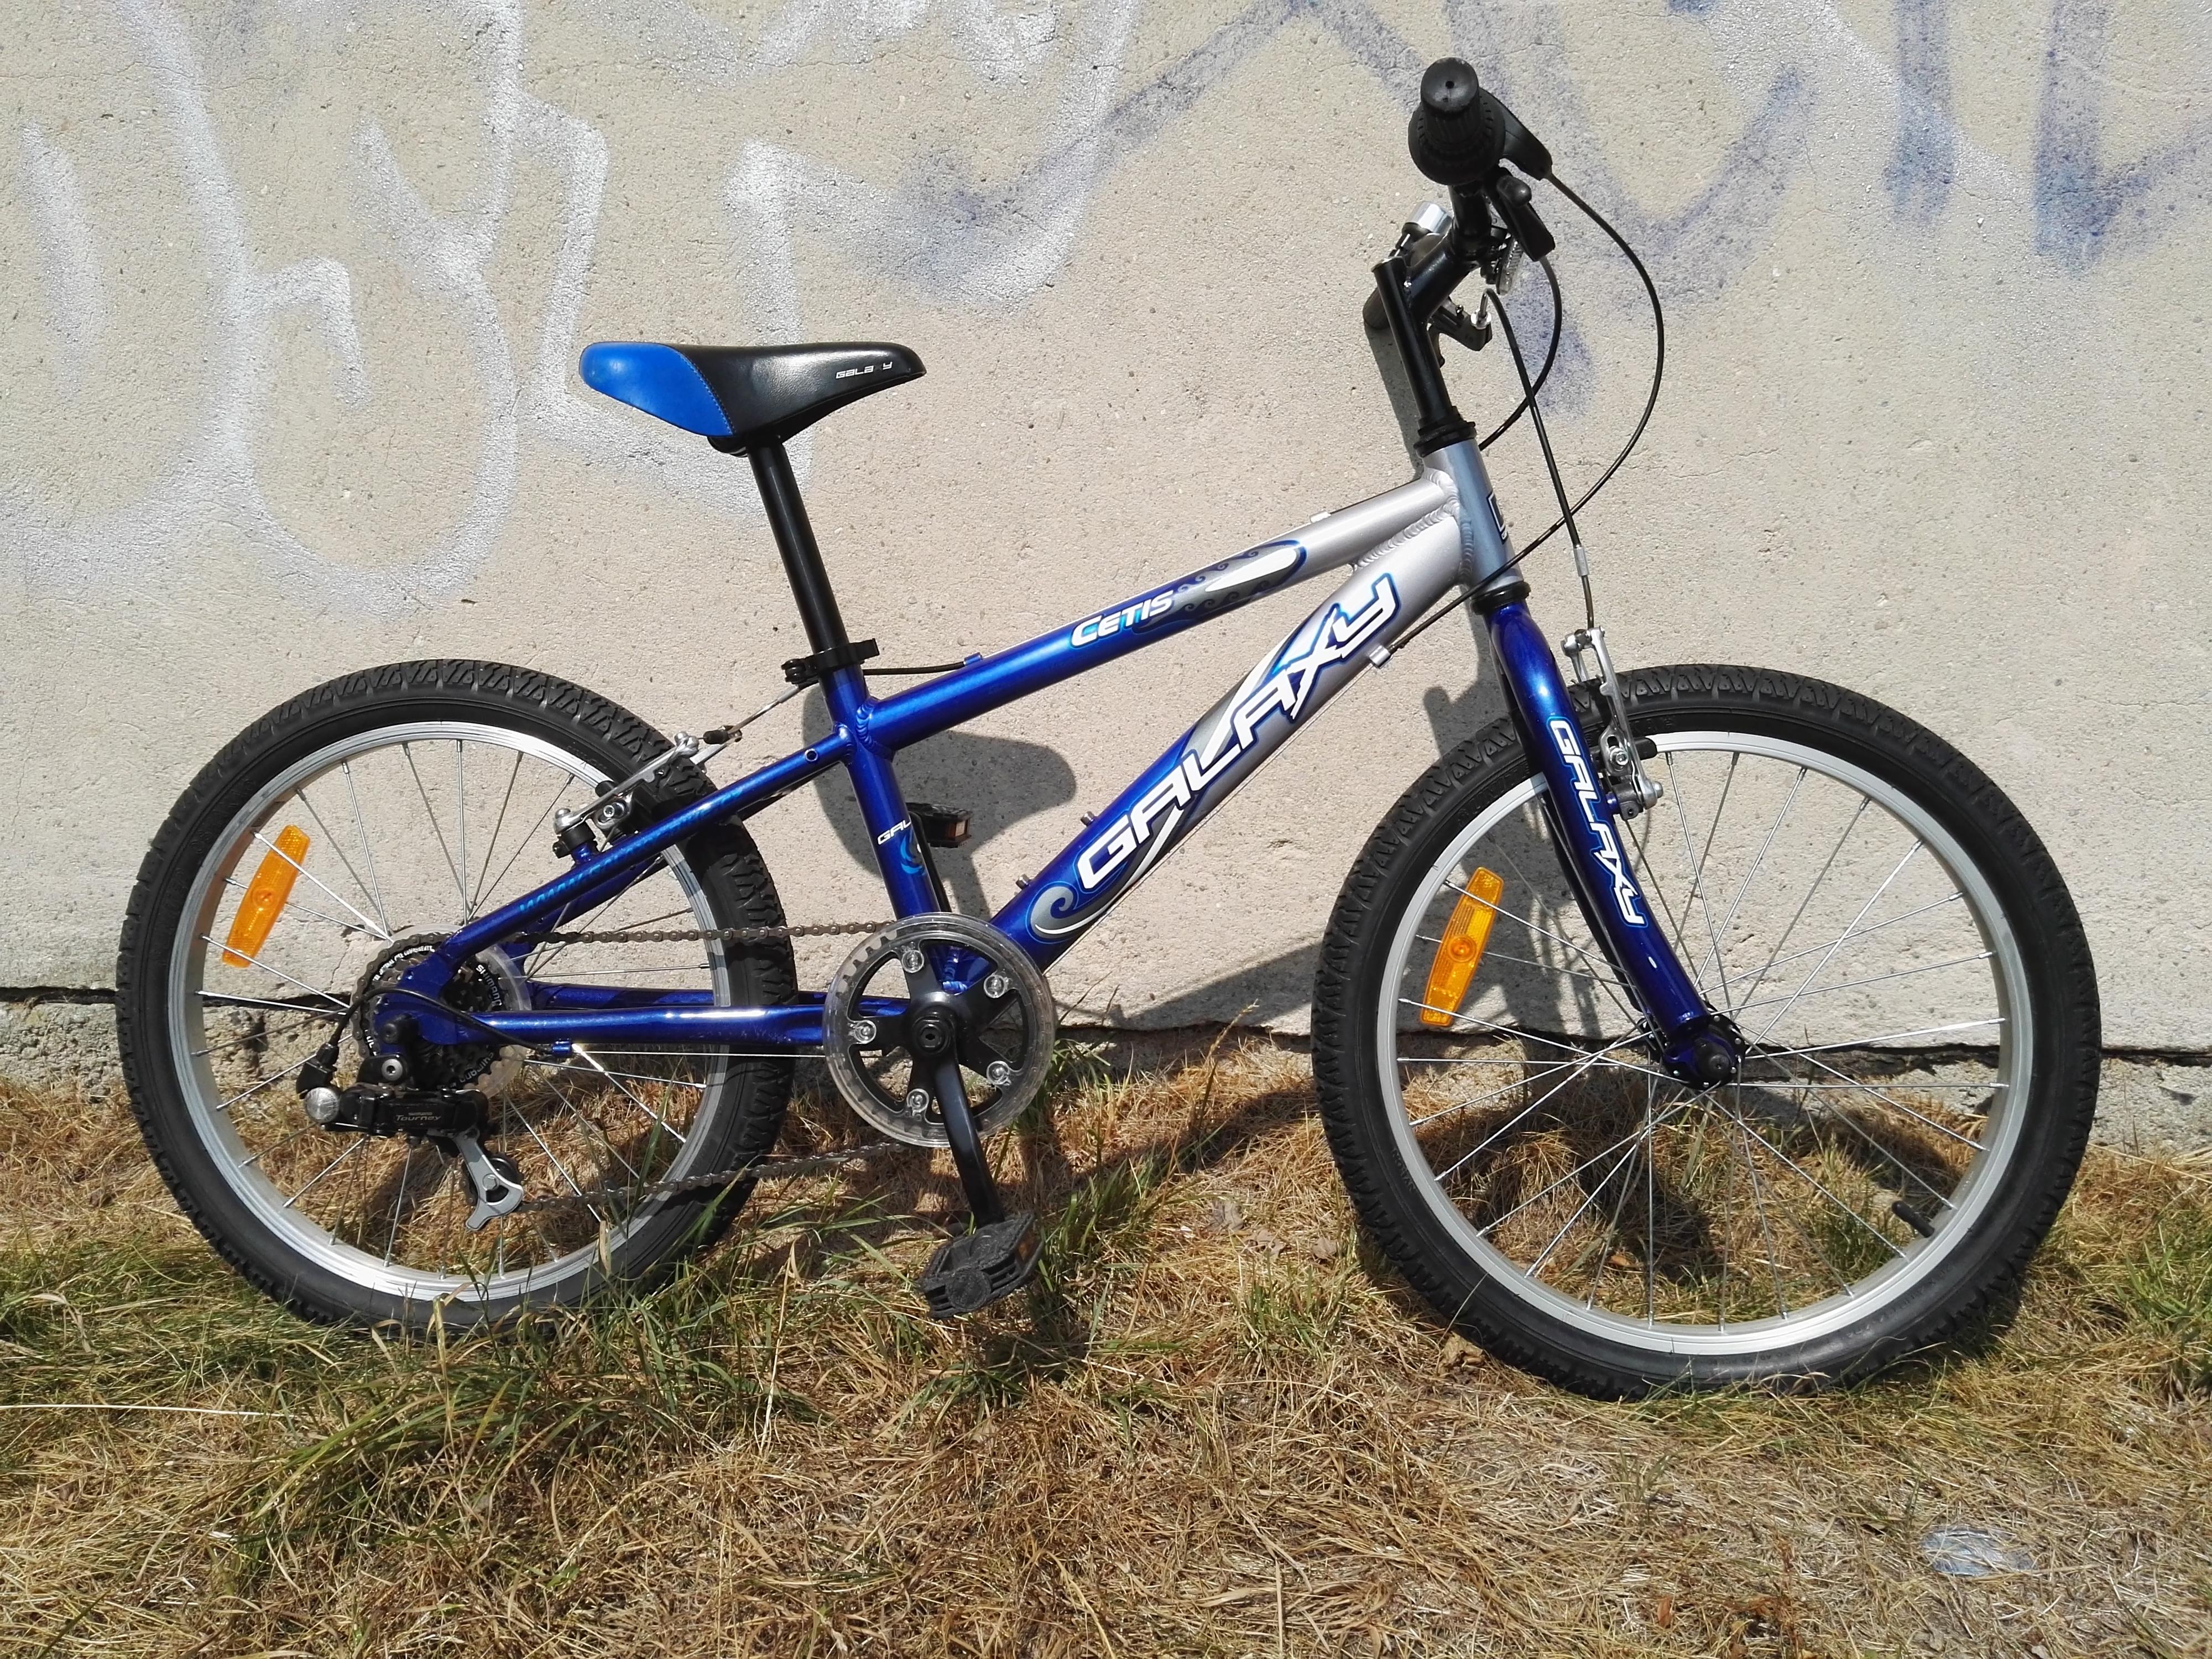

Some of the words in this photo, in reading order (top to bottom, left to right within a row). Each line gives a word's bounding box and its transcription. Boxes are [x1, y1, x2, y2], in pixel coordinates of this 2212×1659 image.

[1071, 590, 1173, 646] CETIS
[1077, 578, 1396, 889] GALAXY
[1550, 720, 1645, 925] GALAXY
